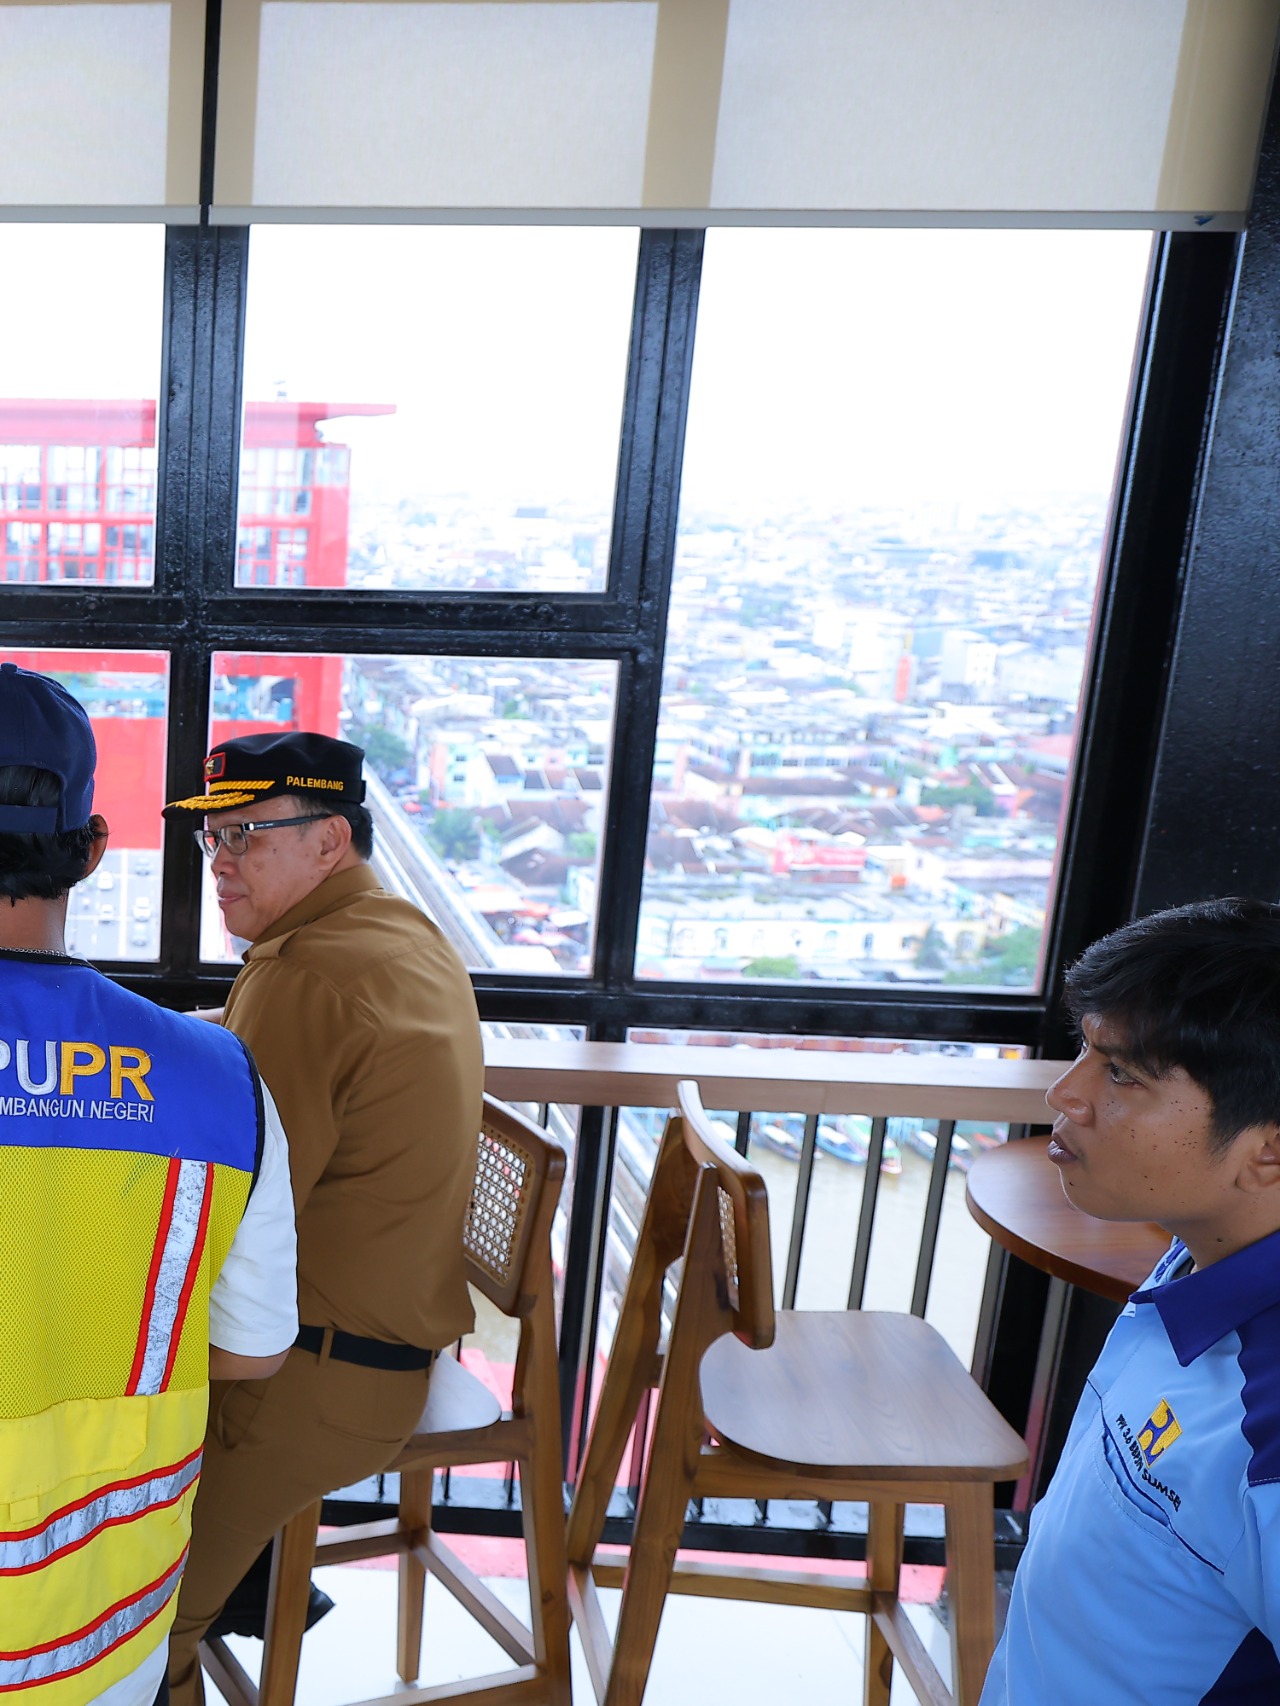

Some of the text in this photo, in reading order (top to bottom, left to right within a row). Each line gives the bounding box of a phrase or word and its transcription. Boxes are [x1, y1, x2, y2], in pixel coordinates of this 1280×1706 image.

[286, 776, 344, 791] PALEMBANG
[90, 1101, 154, 1123] NEGERI
[1122, 1427, 1133, 1445] 3.6
[1141, 1468, 1182, 1512] SUMSEL
